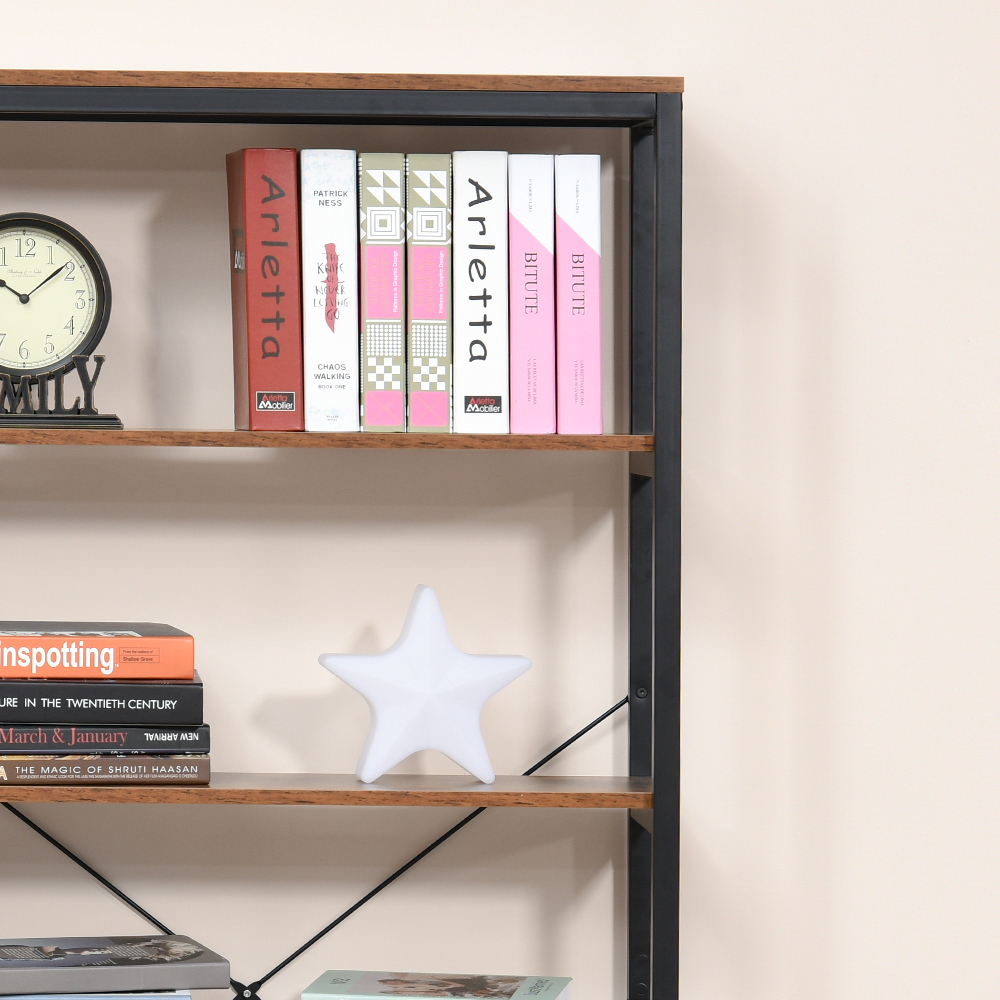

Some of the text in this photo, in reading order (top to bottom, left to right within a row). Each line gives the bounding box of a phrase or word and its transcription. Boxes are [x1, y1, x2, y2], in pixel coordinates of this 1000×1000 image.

[14, 237, 36, 258] 12
[46, 245, 56, 265] 1
[63, 262, 76, 282] 2
[261, 174, 288, 359] Arletta
[467, 177, 496, 363] Arletta
[524, 252, 539, 315] BITUTE
[571, 253, 586, 316] BITUTE
[75, 290, 86, 310] 3
[63, 315, 75, 336] 4
[18, 339, 30, 360] 6
[43, 334, 55, 355] 5
[313, 373, 351, 381] WALKING
[317, 363, 347, 371] CHAOS
[24, 697, 37, 708] IN
[40, 697, 62, 708] THE
[66, 698, 126, 709] TWENTIETH
[128, 699, 178, 710] CENTURY
[52, 727, 65, 744] &
[67, 727, 128, 747] January
[143, 732, 199, 741] NEW ARRIVAL
[15, 765, 198, 774] THE MAGIC OF SHRUTI HAASAN
